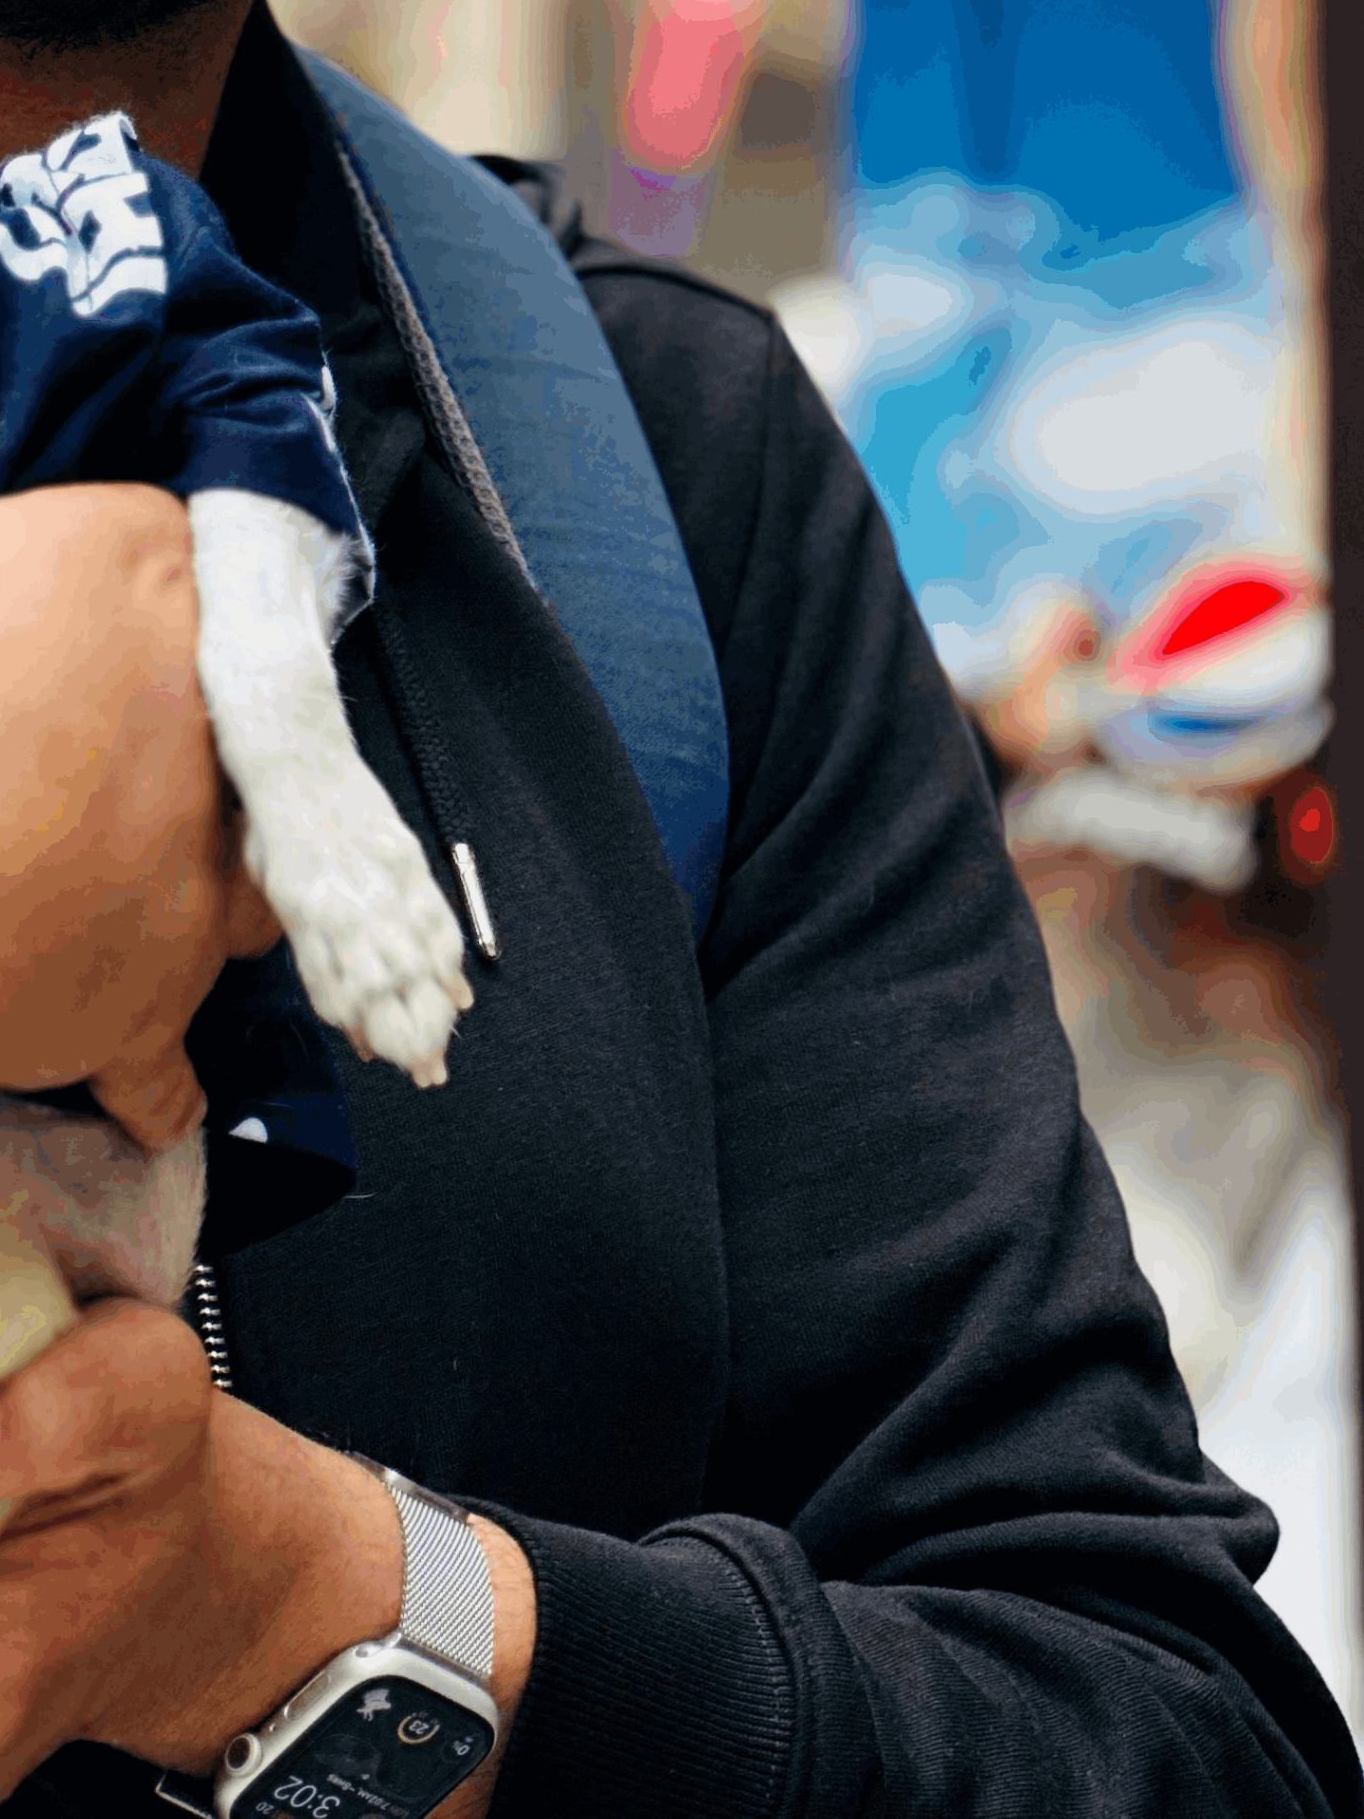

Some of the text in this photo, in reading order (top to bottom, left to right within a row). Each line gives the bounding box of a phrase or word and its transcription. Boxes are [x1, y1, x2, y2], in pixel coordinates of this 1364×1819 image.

[409, 1720, 430, 1735] 23
[273, 1775, 341, 1819] 3:02
[255, 1800, 275, 1815] 20
